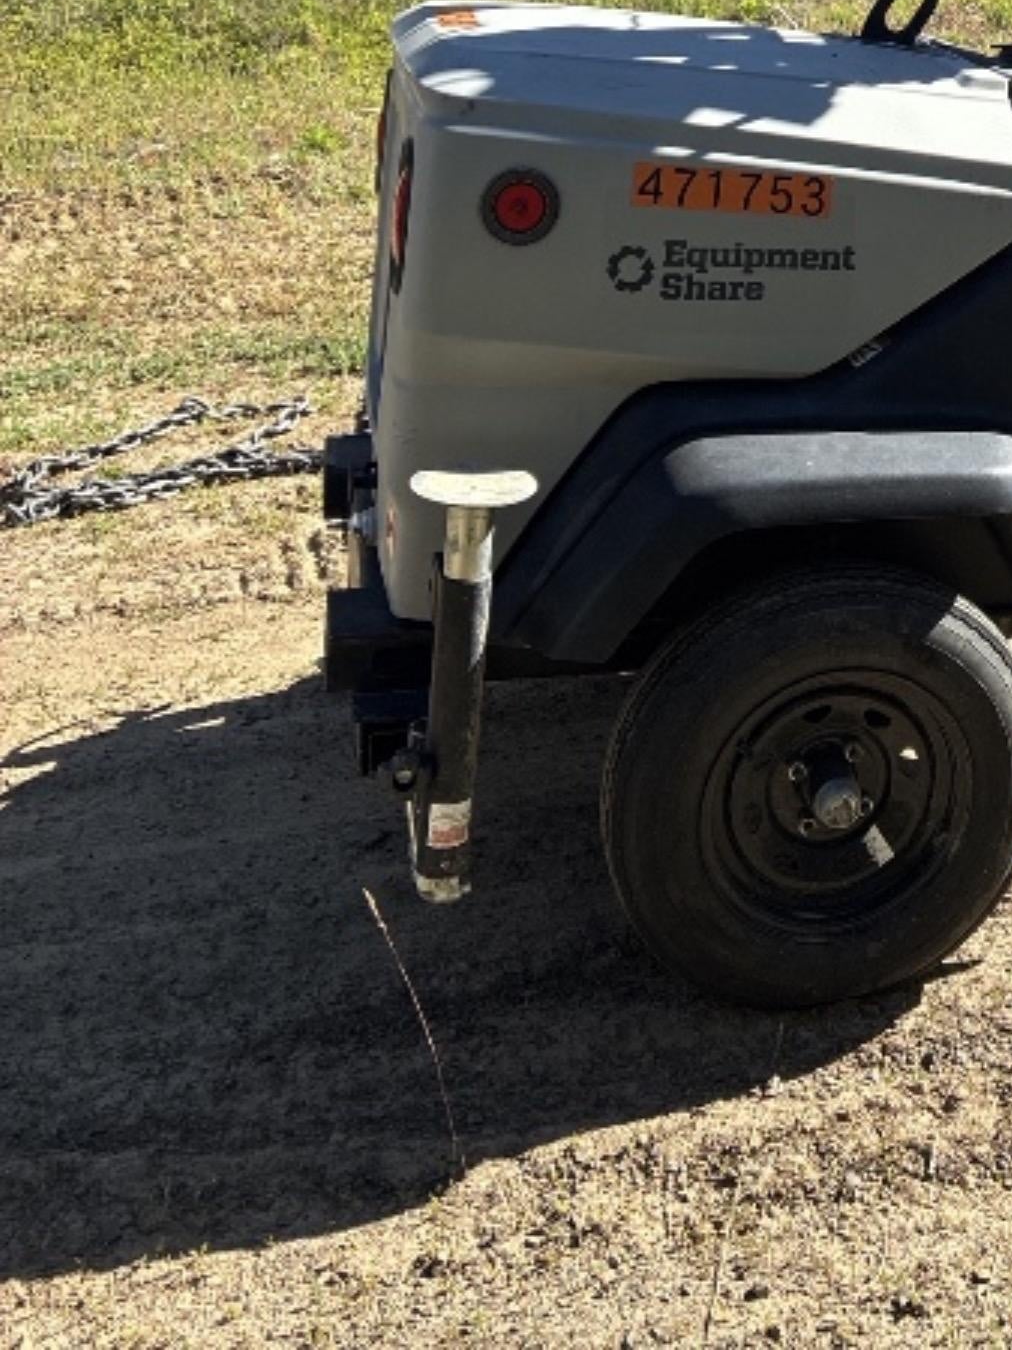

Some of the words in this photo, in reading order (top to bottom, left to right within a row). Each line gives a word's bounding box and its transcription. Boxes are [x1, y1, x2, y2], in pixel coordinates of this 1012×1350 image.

[637, 167, 827, 217] 471753
[662, 239, 856, 274] Equipment
[659, 272, 766, 302] Share
